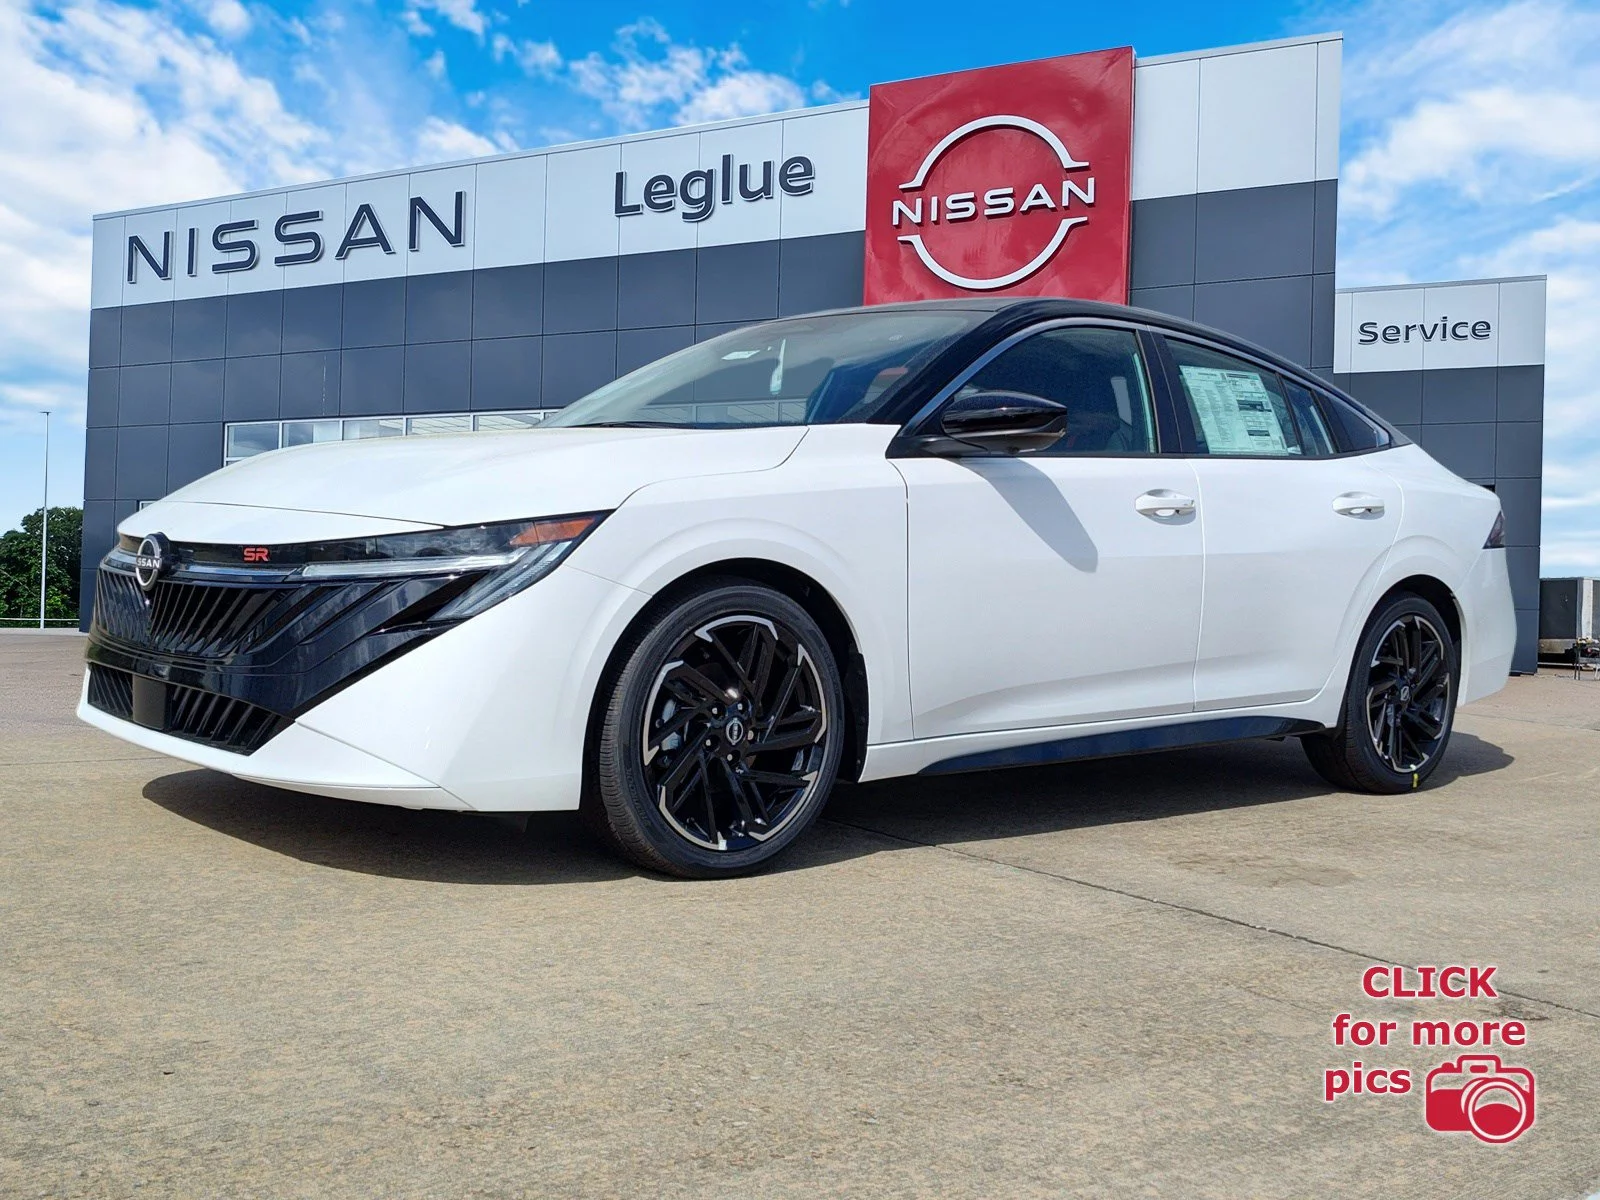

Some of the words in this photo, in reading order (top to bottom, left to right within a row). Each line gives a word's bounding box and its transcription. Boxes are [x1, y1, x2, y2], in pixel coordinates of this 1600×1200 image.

[614, 153, 815, 222] Leglue
[892, 177, 1096, 227] NISSAN
[127, 190, 466, 284] NISSAN
[1358, 315, 1492, 345] Service
[136, 557, 161, 569] SSAN
[243, 547, 270, 562] SR
